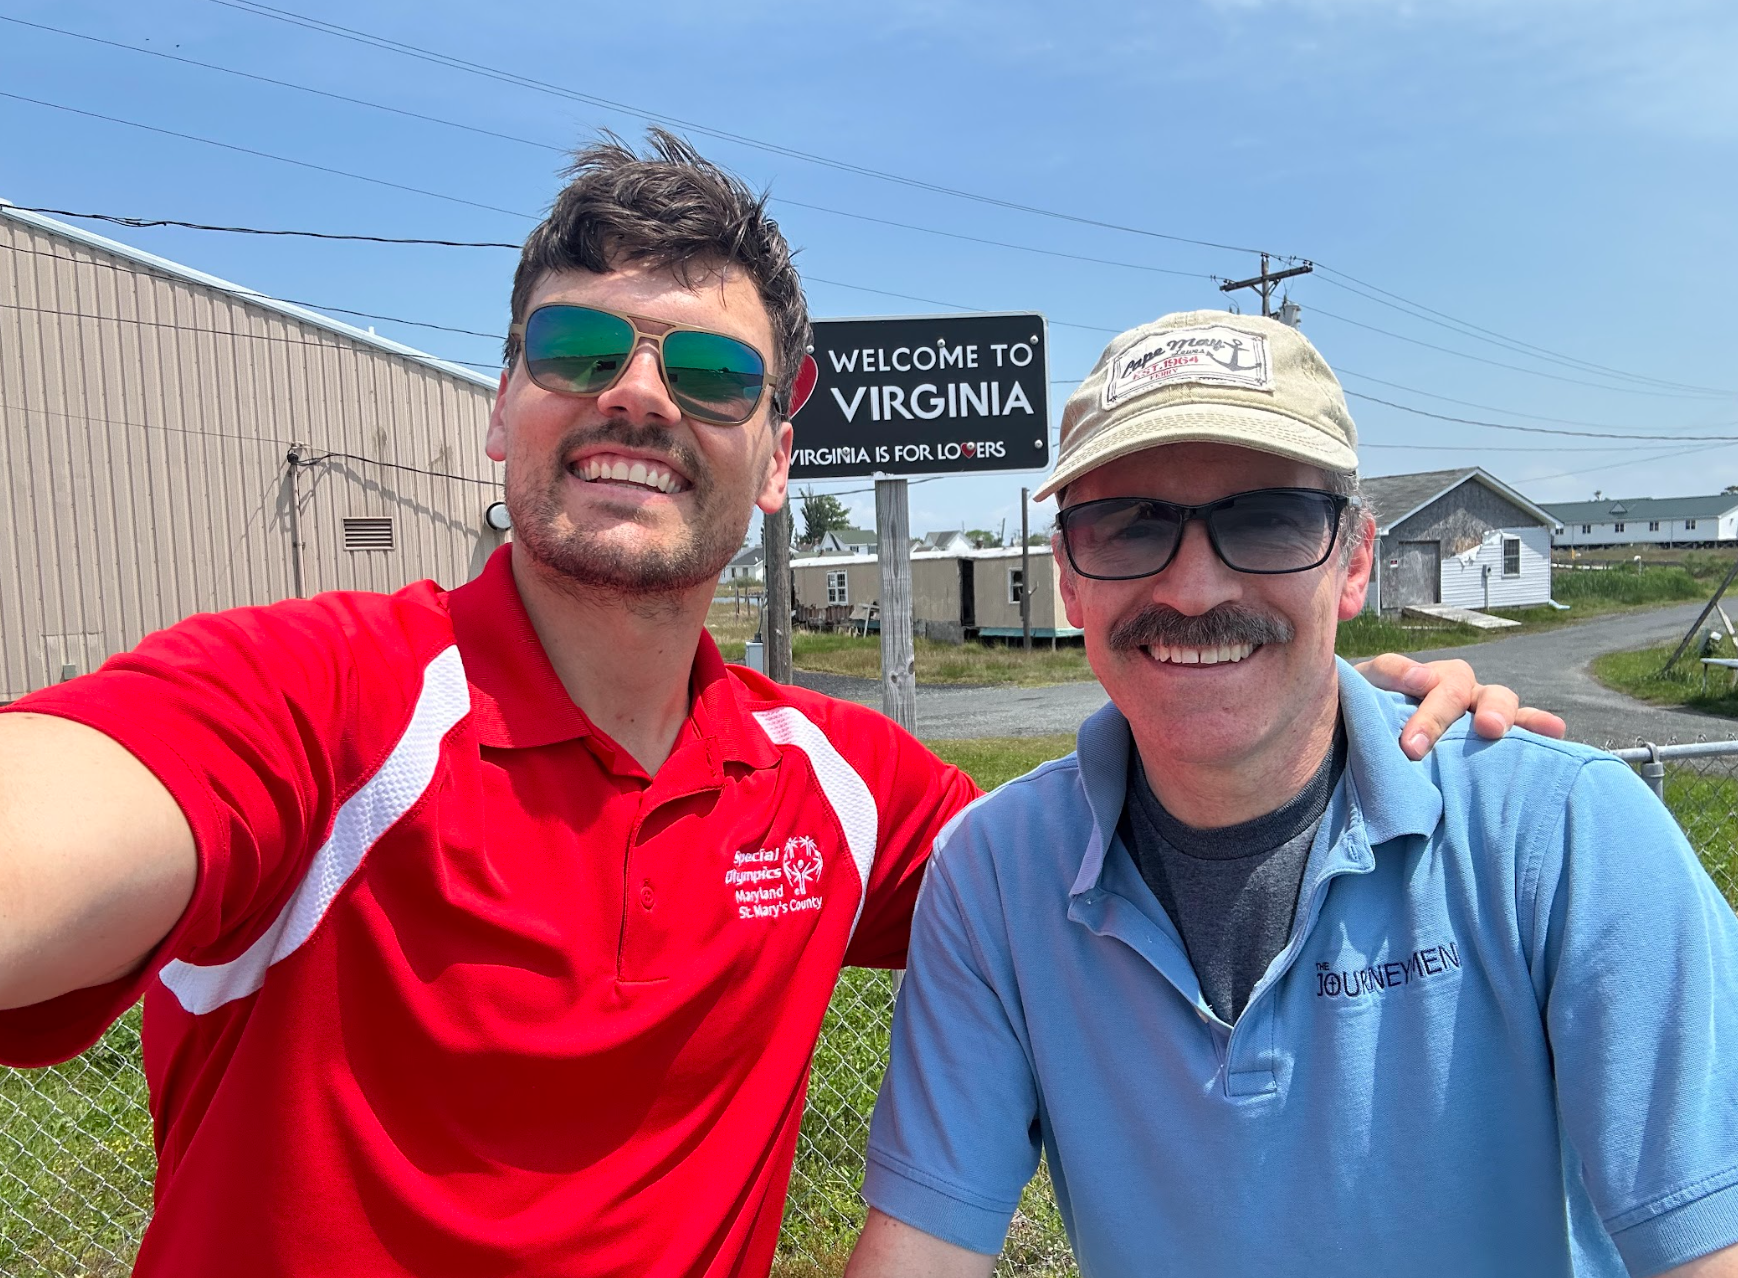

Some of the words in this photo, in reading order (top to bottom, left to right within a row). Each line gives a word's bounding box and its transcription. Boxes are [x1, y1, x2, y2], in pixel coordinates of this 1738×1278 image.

[828, 345, 978, 373] WELCOME
[990, 343, 1033, 367] TO
[1122, 347, 1166, 379] Cape
[1167, 338, 1226, 351] May
[830, 380, 1034, 424] VIRGINIA
[875, 446, 890, 463] IS
[895, 444, 933, 462] FOR
[733, 847, 780, 866] Special
[725, 866, 782, 885] Olympics
[735, 884, 784, 904] Maryland
[789, 896, 823, 911] County
[1316, 962, 1330, 971] THE
[1316, 942, 1463, 998] JOURNEYMEN
